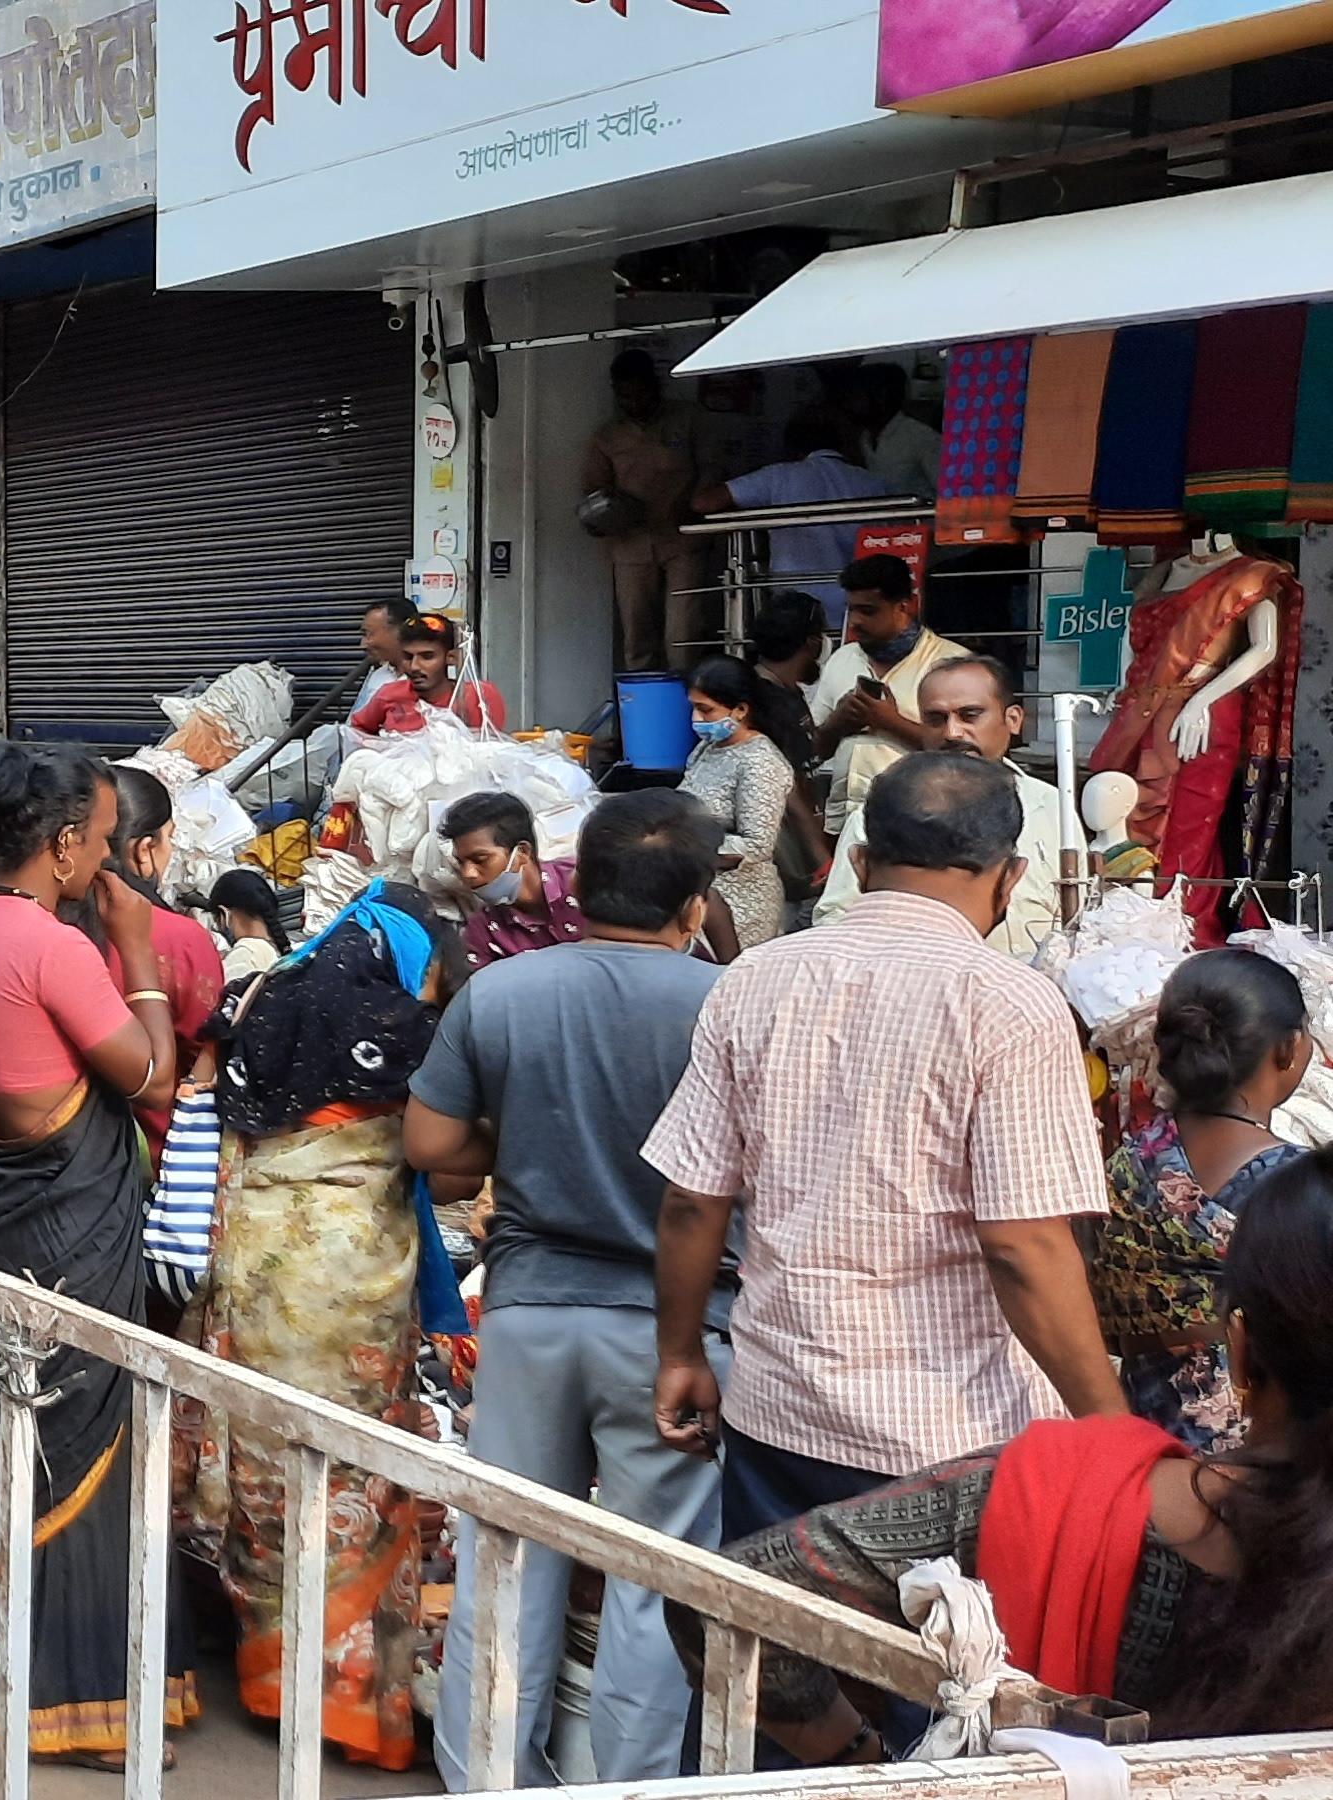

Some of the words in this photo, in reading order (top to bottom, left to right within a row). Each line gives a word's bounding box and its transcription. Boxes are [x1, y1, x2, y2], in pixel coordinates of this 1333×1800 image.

[456, 118, 588, 180] आपलेपणाचा
[8, 159, 84, 222] दुकान
[1058, 598, 1133, 638] Bisler
